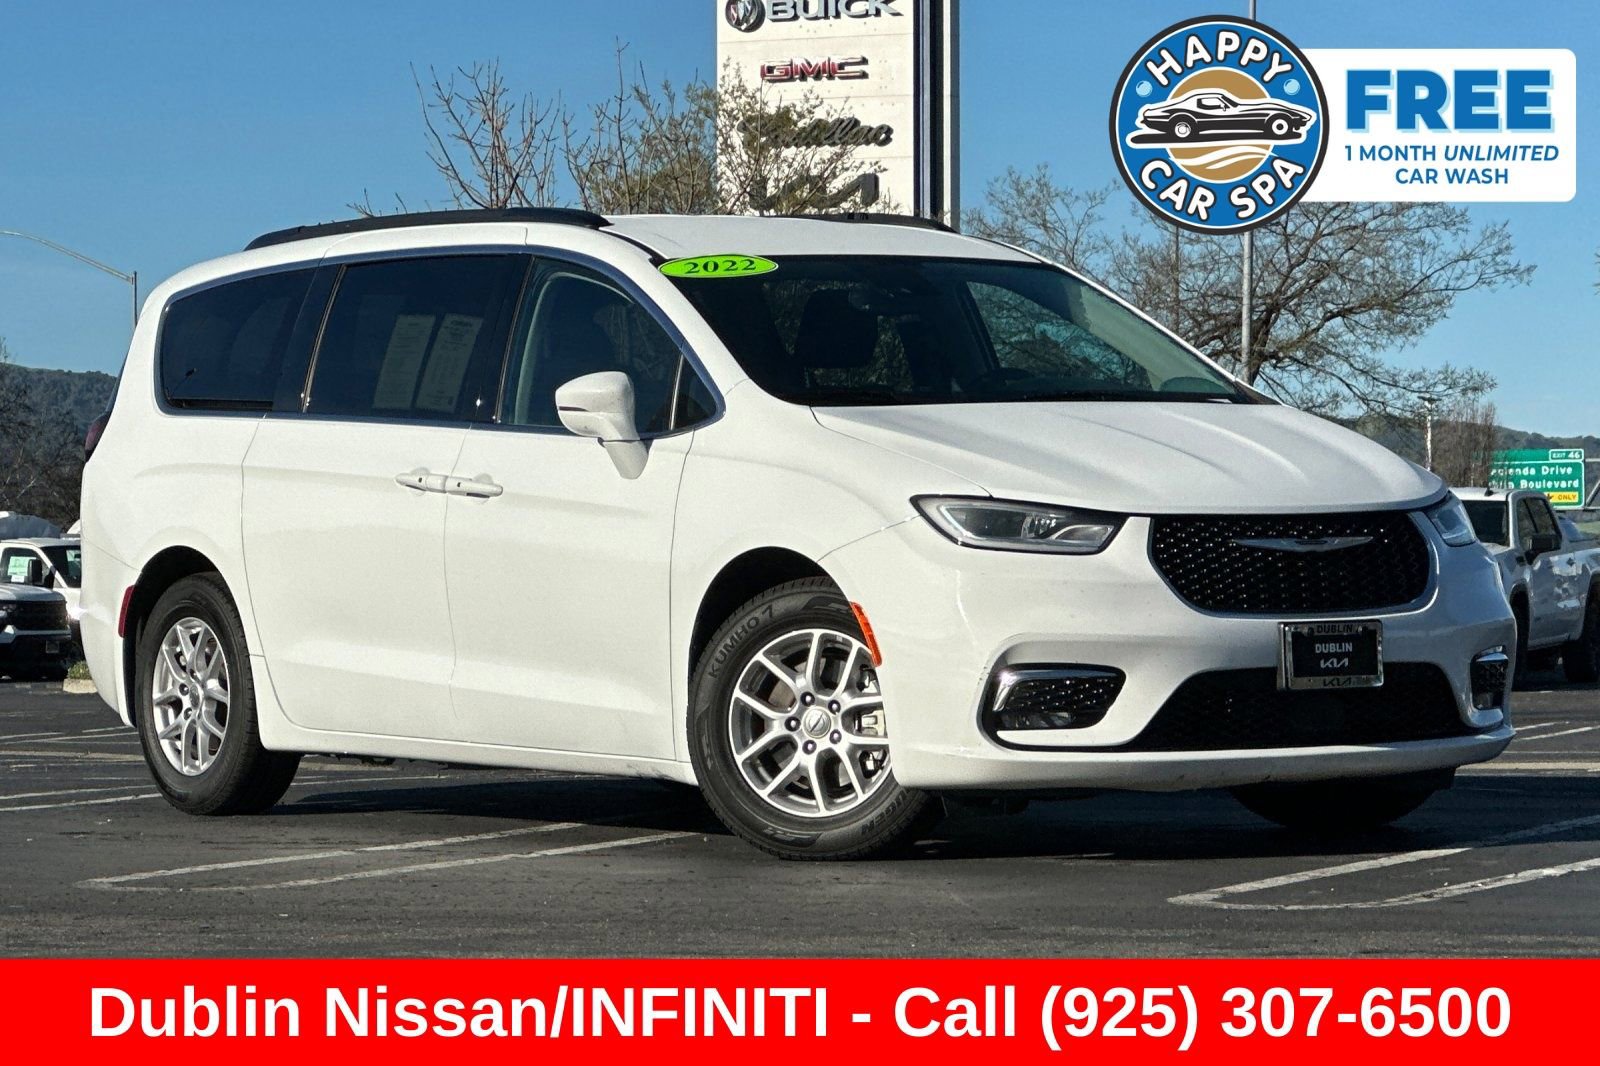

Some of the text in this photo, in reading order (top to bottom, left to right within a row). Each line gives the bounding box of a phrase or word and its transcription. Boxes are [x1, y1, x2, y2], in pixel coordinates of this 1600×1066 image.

[767, 0, 902, 20] BUICK
[761, 56, 867, 81] GMC
[684, 259, 757, 274] 2022
[1567, 451, 1580, 459] 46
[1541, 466, 1573, 476] Drive
[1520, 479, 1579, 490] Boulevard
[1557, 493, 1577, 501] ONLY
[1316, 624, 1354, 634] DUBLIN
[708, 616, 760, 679] KUMHO
[1315, 642, 1353, 654] DUBLIN
